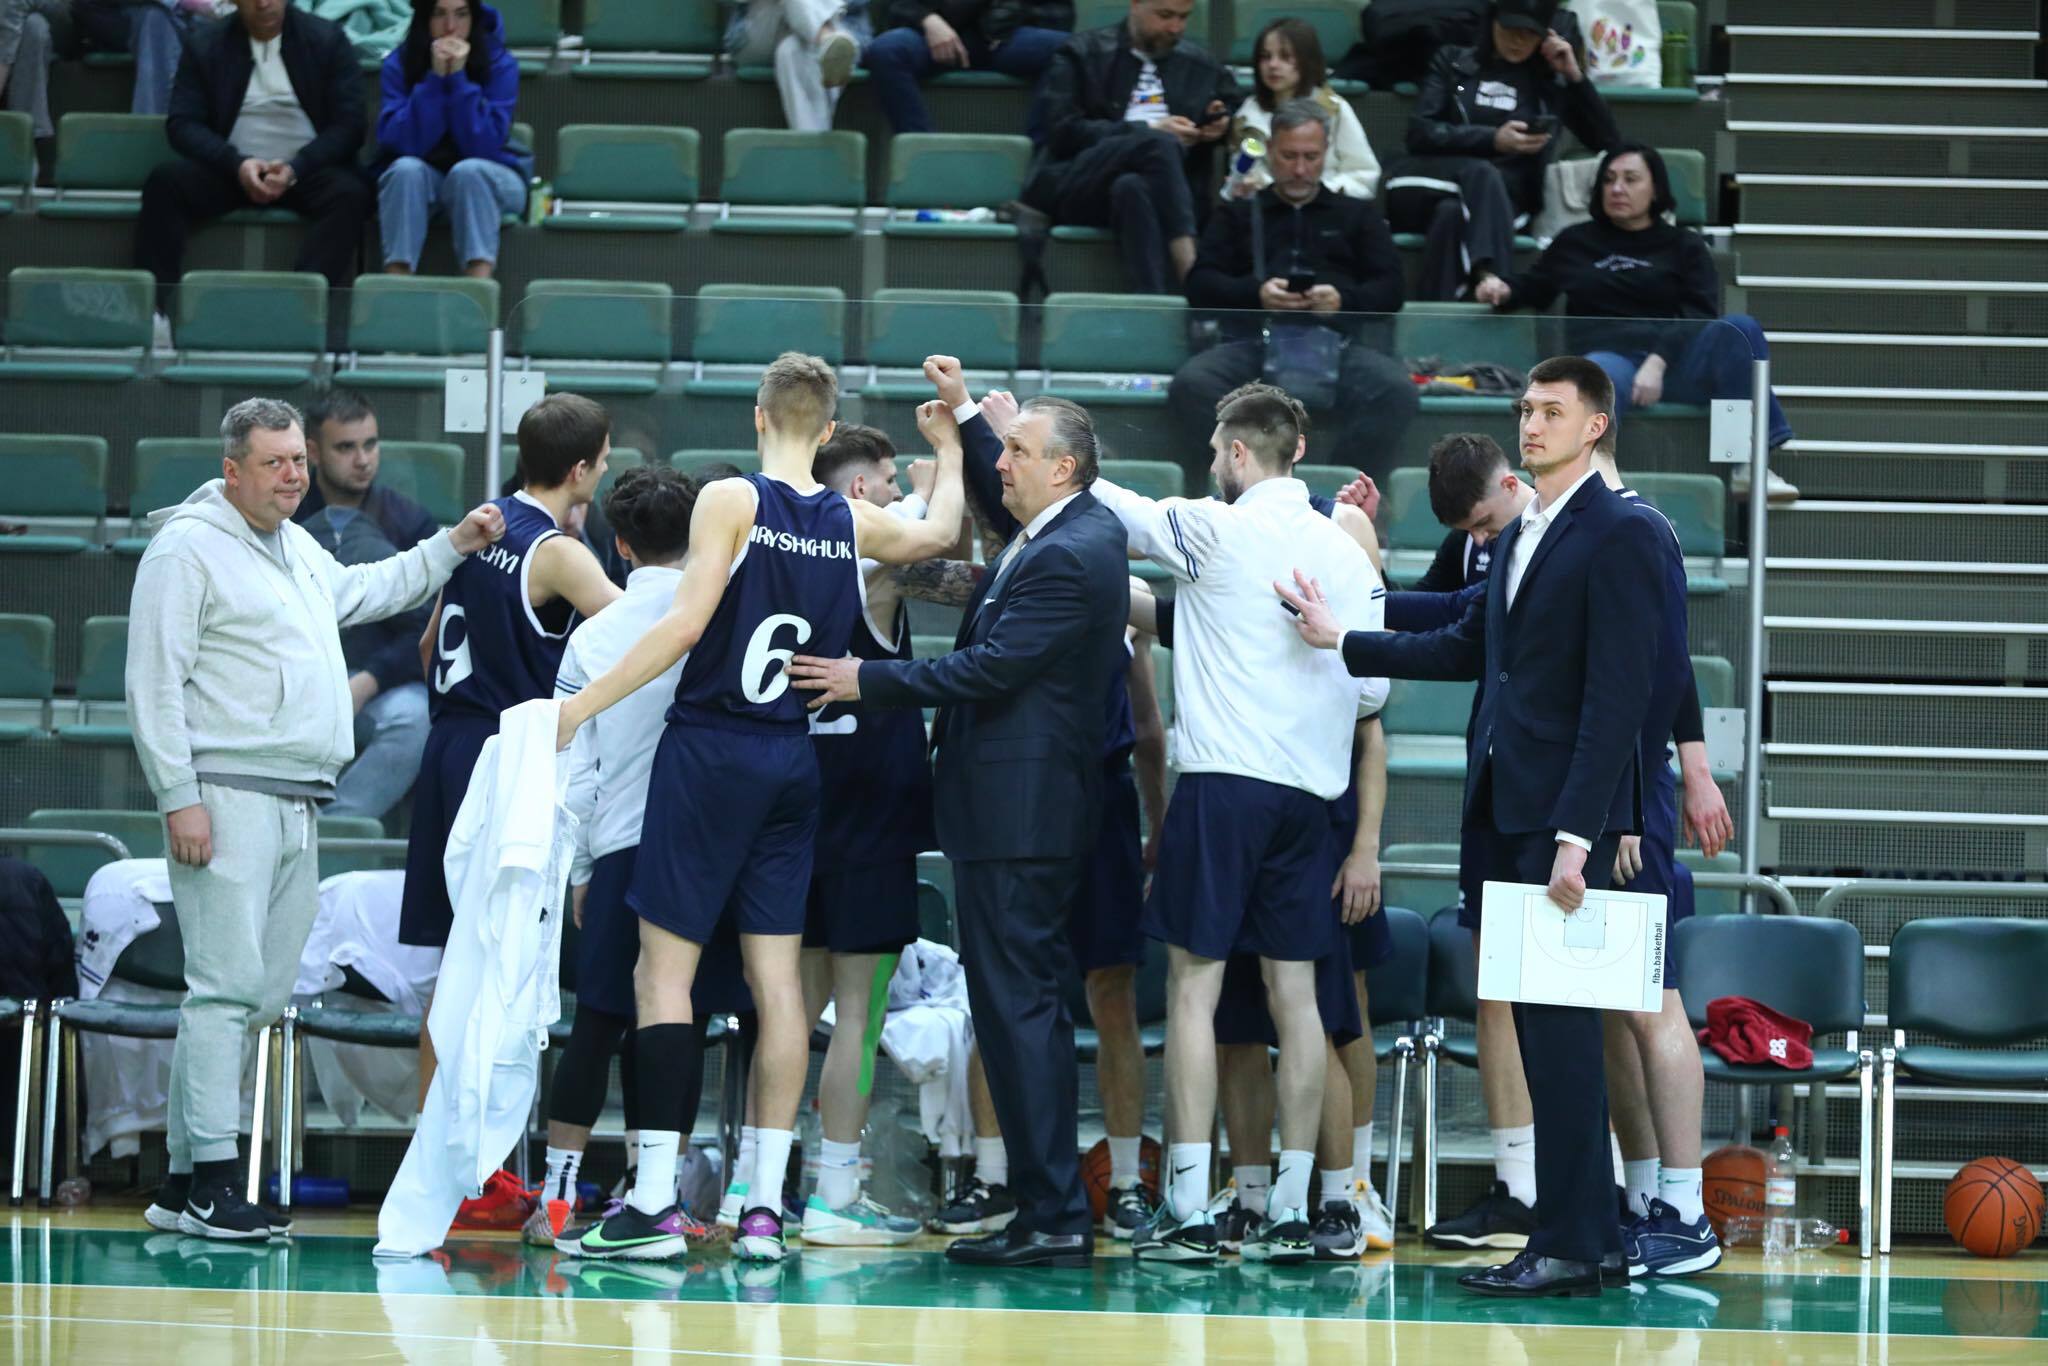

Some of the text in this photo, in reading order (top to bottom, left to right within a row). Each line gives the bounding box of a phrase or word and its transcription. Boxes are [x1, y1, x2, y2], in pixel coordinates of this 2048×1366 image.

[435, 603, 473, 694] 9
[741, 613, 812, 704] 6
[1652, 922, 1663, 984] fiba.basketball
